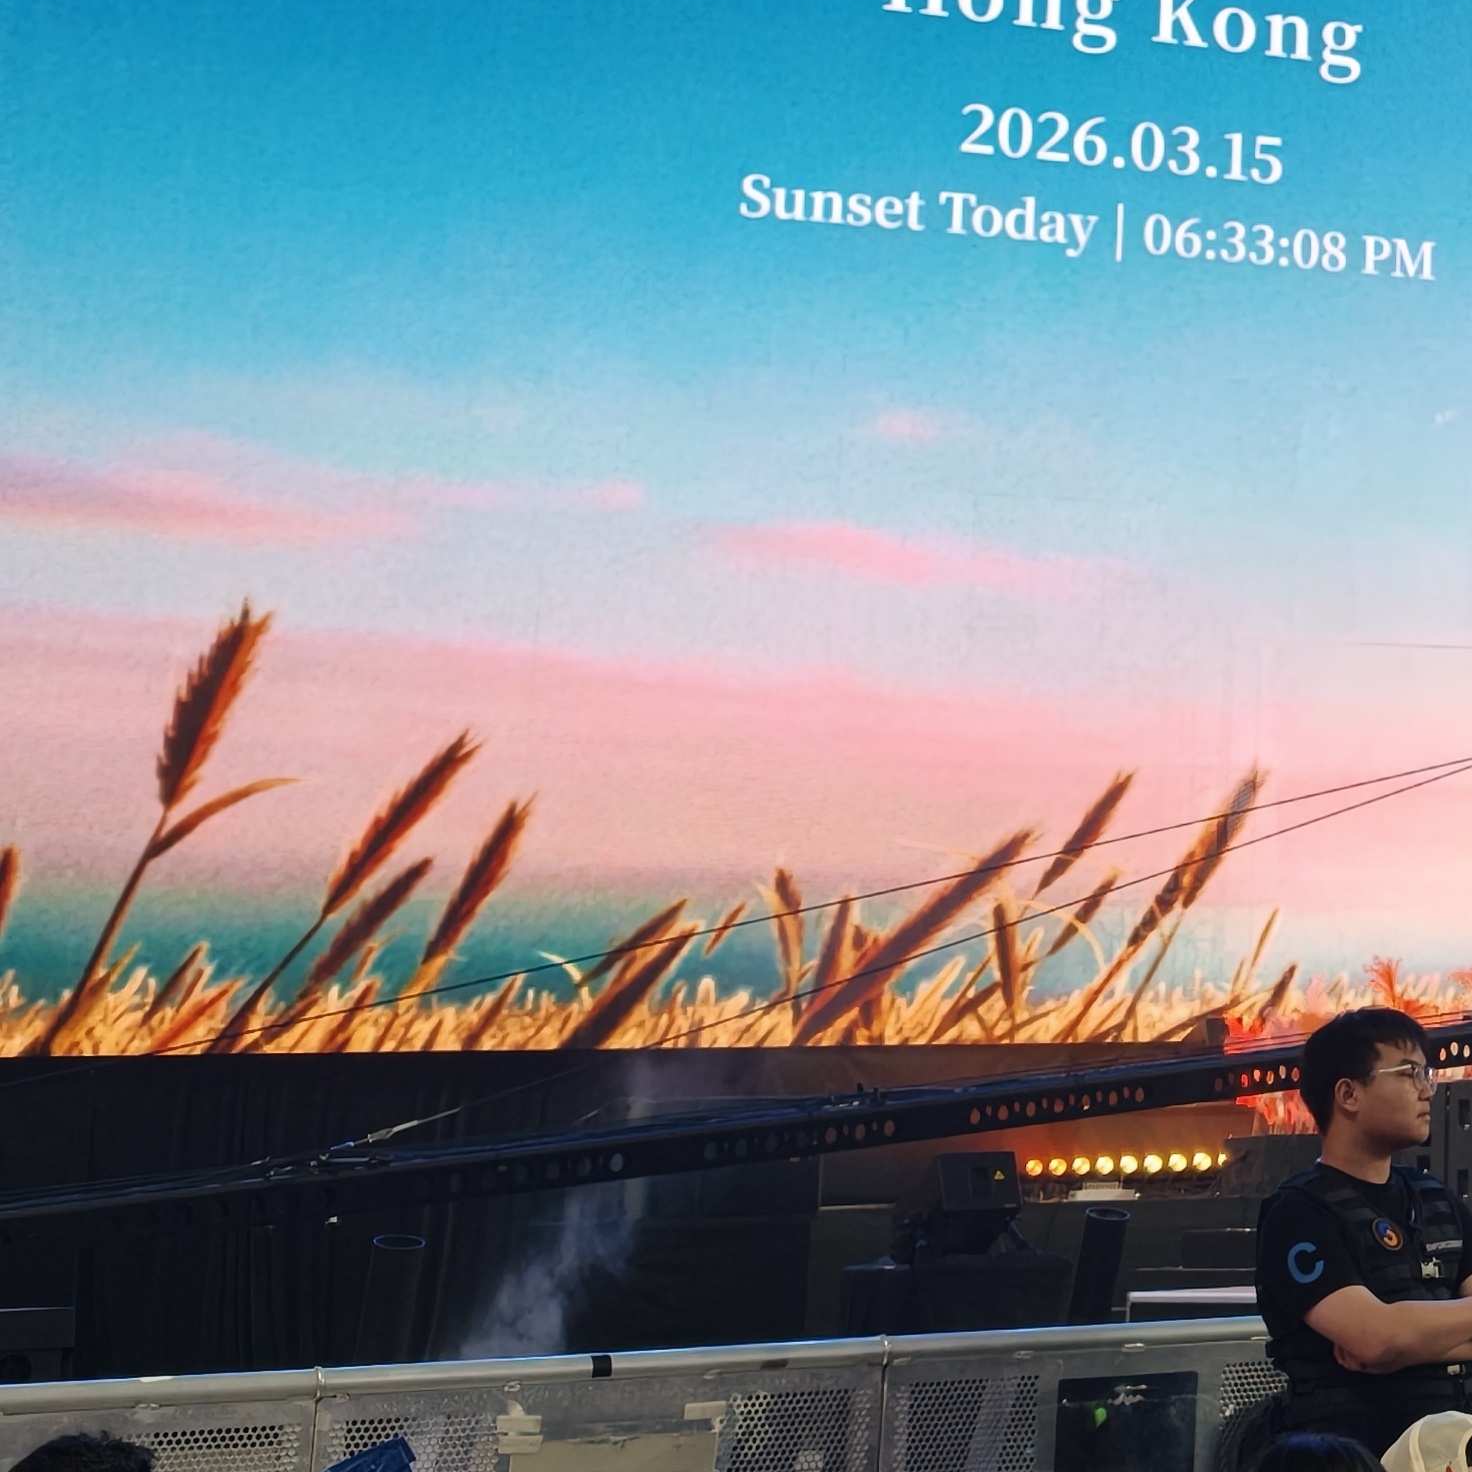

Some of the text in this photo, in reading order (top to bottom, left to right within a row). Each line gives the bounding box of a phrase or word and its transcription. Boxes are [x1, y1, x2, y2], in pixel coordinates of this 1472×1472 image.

[960, 103, 1284, 185] 2026.03.15
[739, 173, 924, 231] Sunset
[939, 191, 1099, 258] Today
[1143, 213, 1347, 273] 06:33:08
[1361, 235, 1436, 282] PM
